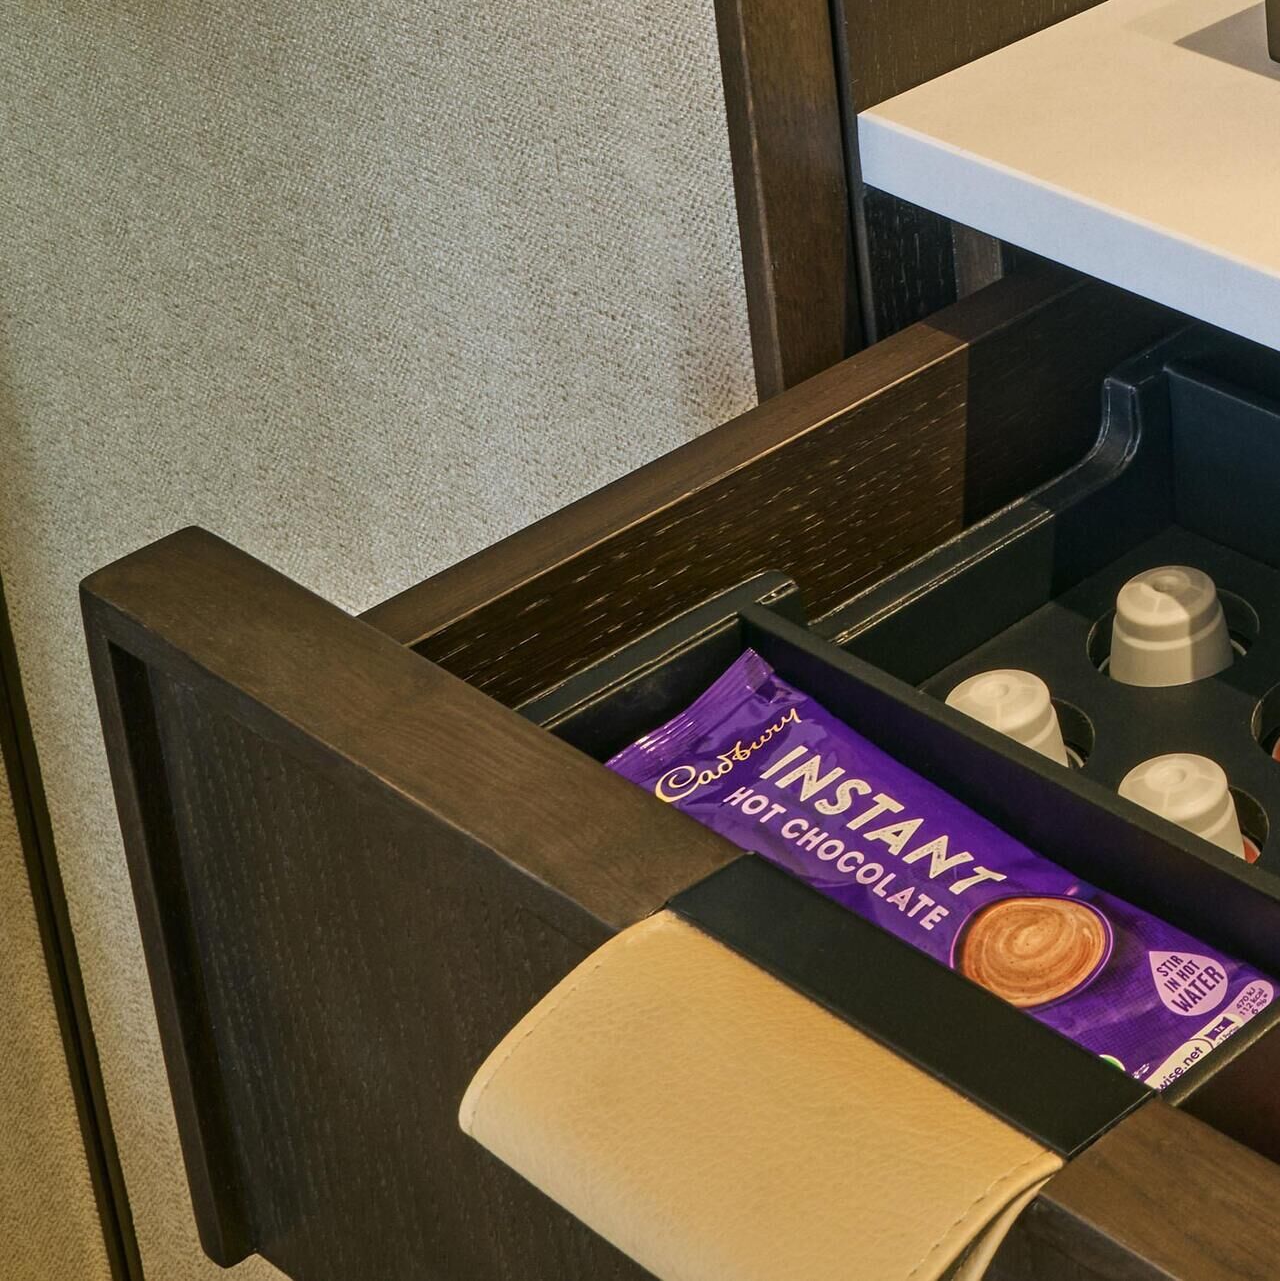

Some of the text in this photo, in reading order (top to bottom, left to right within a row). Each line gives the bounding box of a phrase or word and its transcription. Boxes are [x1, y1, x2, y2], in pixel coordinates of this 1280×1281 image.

[654, 707, 803, 804] Cadbury
[759, 745, 1008, 896] INSTANT
[723, 785, 950, 931] HOT CHOCOLATE
[1156, 955, 1184, 978] STIR
[1163, 959, 1201, 994] IN HOT
[1171, 965, 1225, 1013] WATER
[1250, 987, 1265, 1005] kcal
